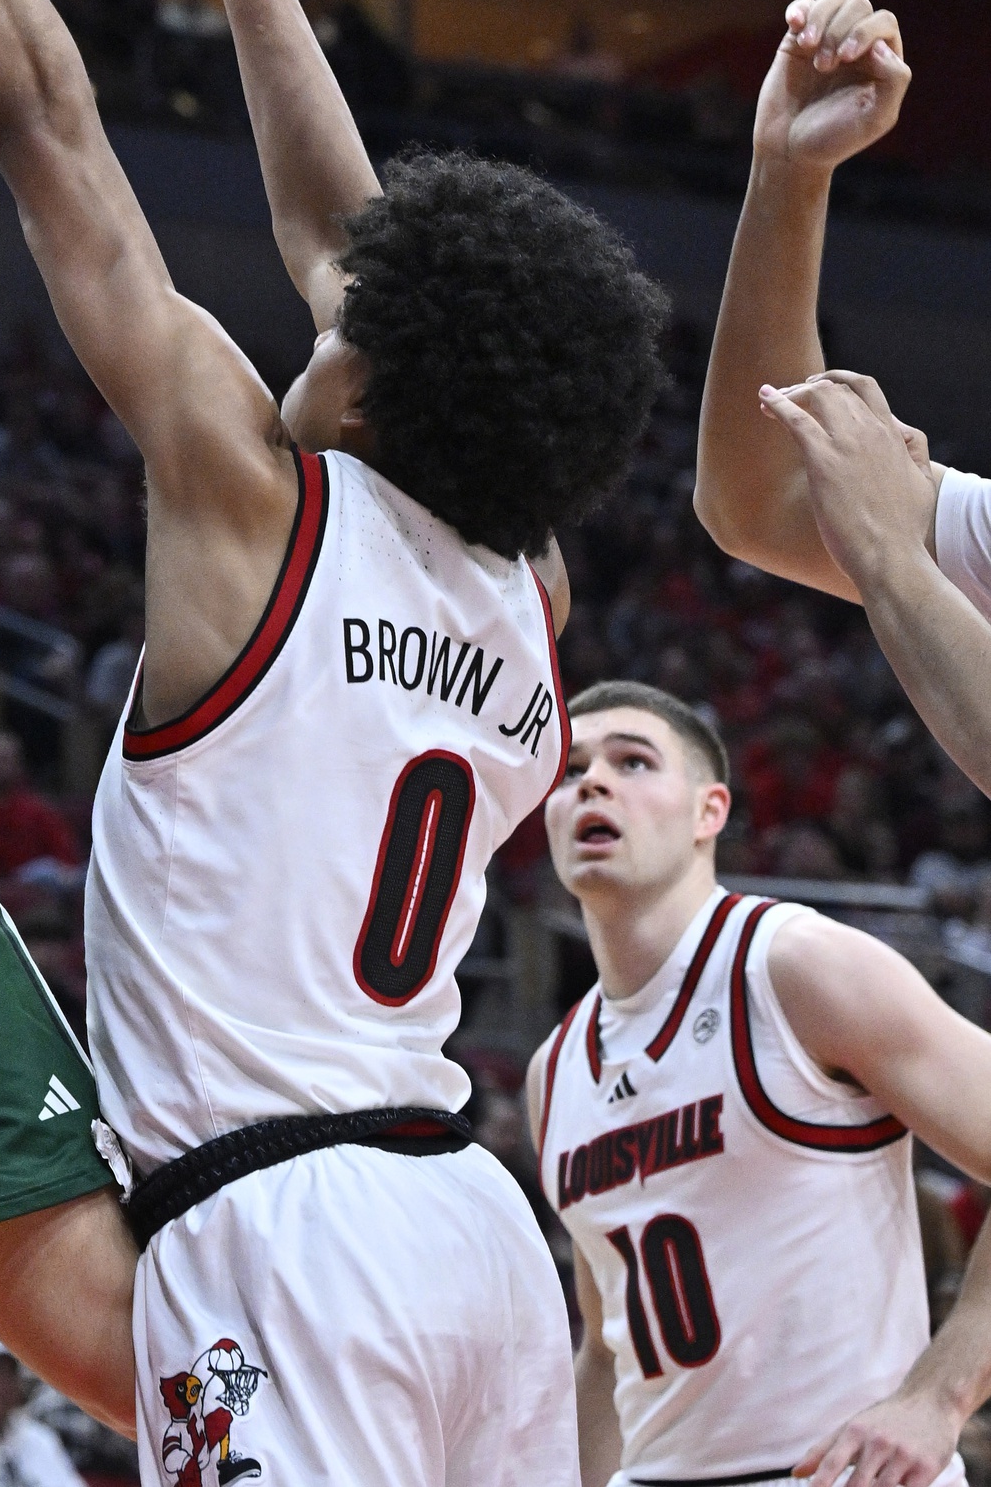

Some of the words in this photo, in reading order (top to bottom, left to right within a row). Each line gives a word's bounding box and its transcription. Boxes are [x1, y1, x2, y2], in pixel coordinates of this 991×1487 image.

[342, 618, 504, 716] BROWN
[352, 748, 477, 1008] 0
[558, 1093, 725, 1211] LOUISVILLE
[605, 1212, 722, 1381] 10
